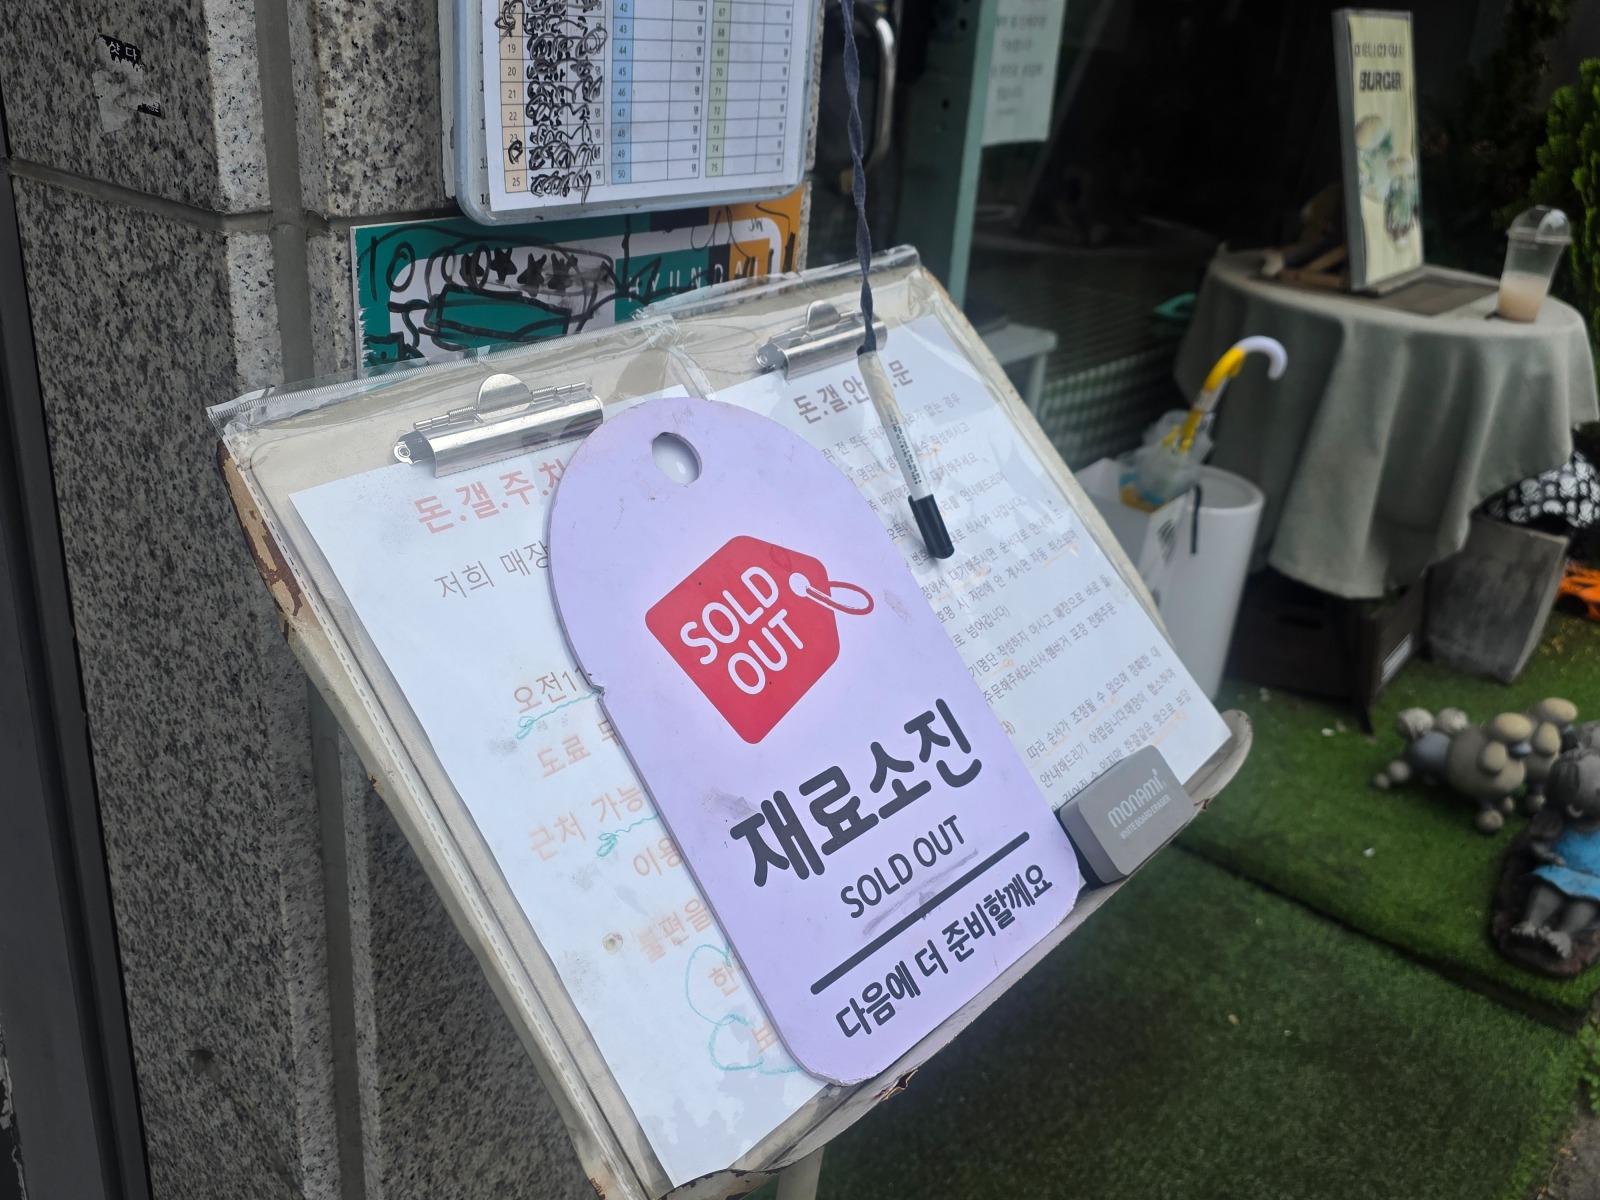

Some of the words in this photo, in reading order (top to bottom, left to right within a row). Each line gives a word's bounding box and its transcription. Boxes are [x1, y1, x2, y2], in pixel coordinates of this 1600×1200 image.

[620, 3, 627, 12] 42
[718, 8, 725, 17] 67
[619, 24, 627, 34] 43
[718, 28, 725, 37] 68
[508, 44, 516, 53] 19
[619, 46, 626, 56] 44
[717, 48, 724, 57] 69
[507, 67, 516, 76] 20
[619, 67, 626, 76] 45
[716, 67, 723, 77] 70
[1360, 71, 1401, 91] BURGER
[508, 89, 516, 99] 21
[618, 87, 625, 97] 46
[714, 87, 721, 96] 71
[618, 108, 625, 117] 47
[714, 106, 721, 116] 72
[508, 112, 517, 121] 22
[618, 129, 625, 138] 48
[713, 125, 720, 135] 73
[509, 133, 518, 143] 23
[618, 149, 625, 158] 49
[712, 144, 719, 153] 74
[711, 163, 718, 172] 75
[617, 169, 625, 178] 50
[512, 177, 520, 186] 25
[834, 440, 850, 456] 전
[947, 547, 998, 581] 대기해주시면
[998, 528, 1030, 554] 순서대로
[434, 561, 495, 599] 저희
[499, 540, 550, 577] 매장
[936, 605, 956, 624] 호명
[955, 597, 970, 611] 시
[968, 580, 995, 601] 자리에
[993, 575, 1006, 588] 안
[1005, 558, 1031, 579] 계시면
[1029, 547, 1048, 562] 자동
[680, 566, 779, 665] SOLD
[965, 605, 1010, 639] 넘어갑니다)
[996, 630, 1030, 656] 작성하지
[1028, 613, 1054, 635] 마시고
[1053, 592, 1085, 618] 매장으로
[1069, 623, 1089, 641] 포장
[1087, 602, 1117, 629] 전화주문
[728, 609, 804, 695] OUT
[1026, 740, 1047, 759] 따라
[1046, 719, 1071, 746] 순서가
[1070, 699, 1097, 724] 조정될
[1095, 691, 1106, 703] 수
[1105, 672, 1129, 695] 있으며
[1152, 702, 1176, 726] 맛으로
[1039, 742, 1088, 788] 안내해드리기
[730, 698, 982, 887] 재료소진
[528, 812, 587, 861] 근처
[591, 785, 646, 826] 가능
[840, 853, 913, 918] SOLD
[913, 815, 965, 868] OUT
[836, 960, 921, 1038] 다음에
[914, 939, 949, 977] 더
[942, 864, 1053, 963] 준비할께요
[709, 962, 740, 998] 한
